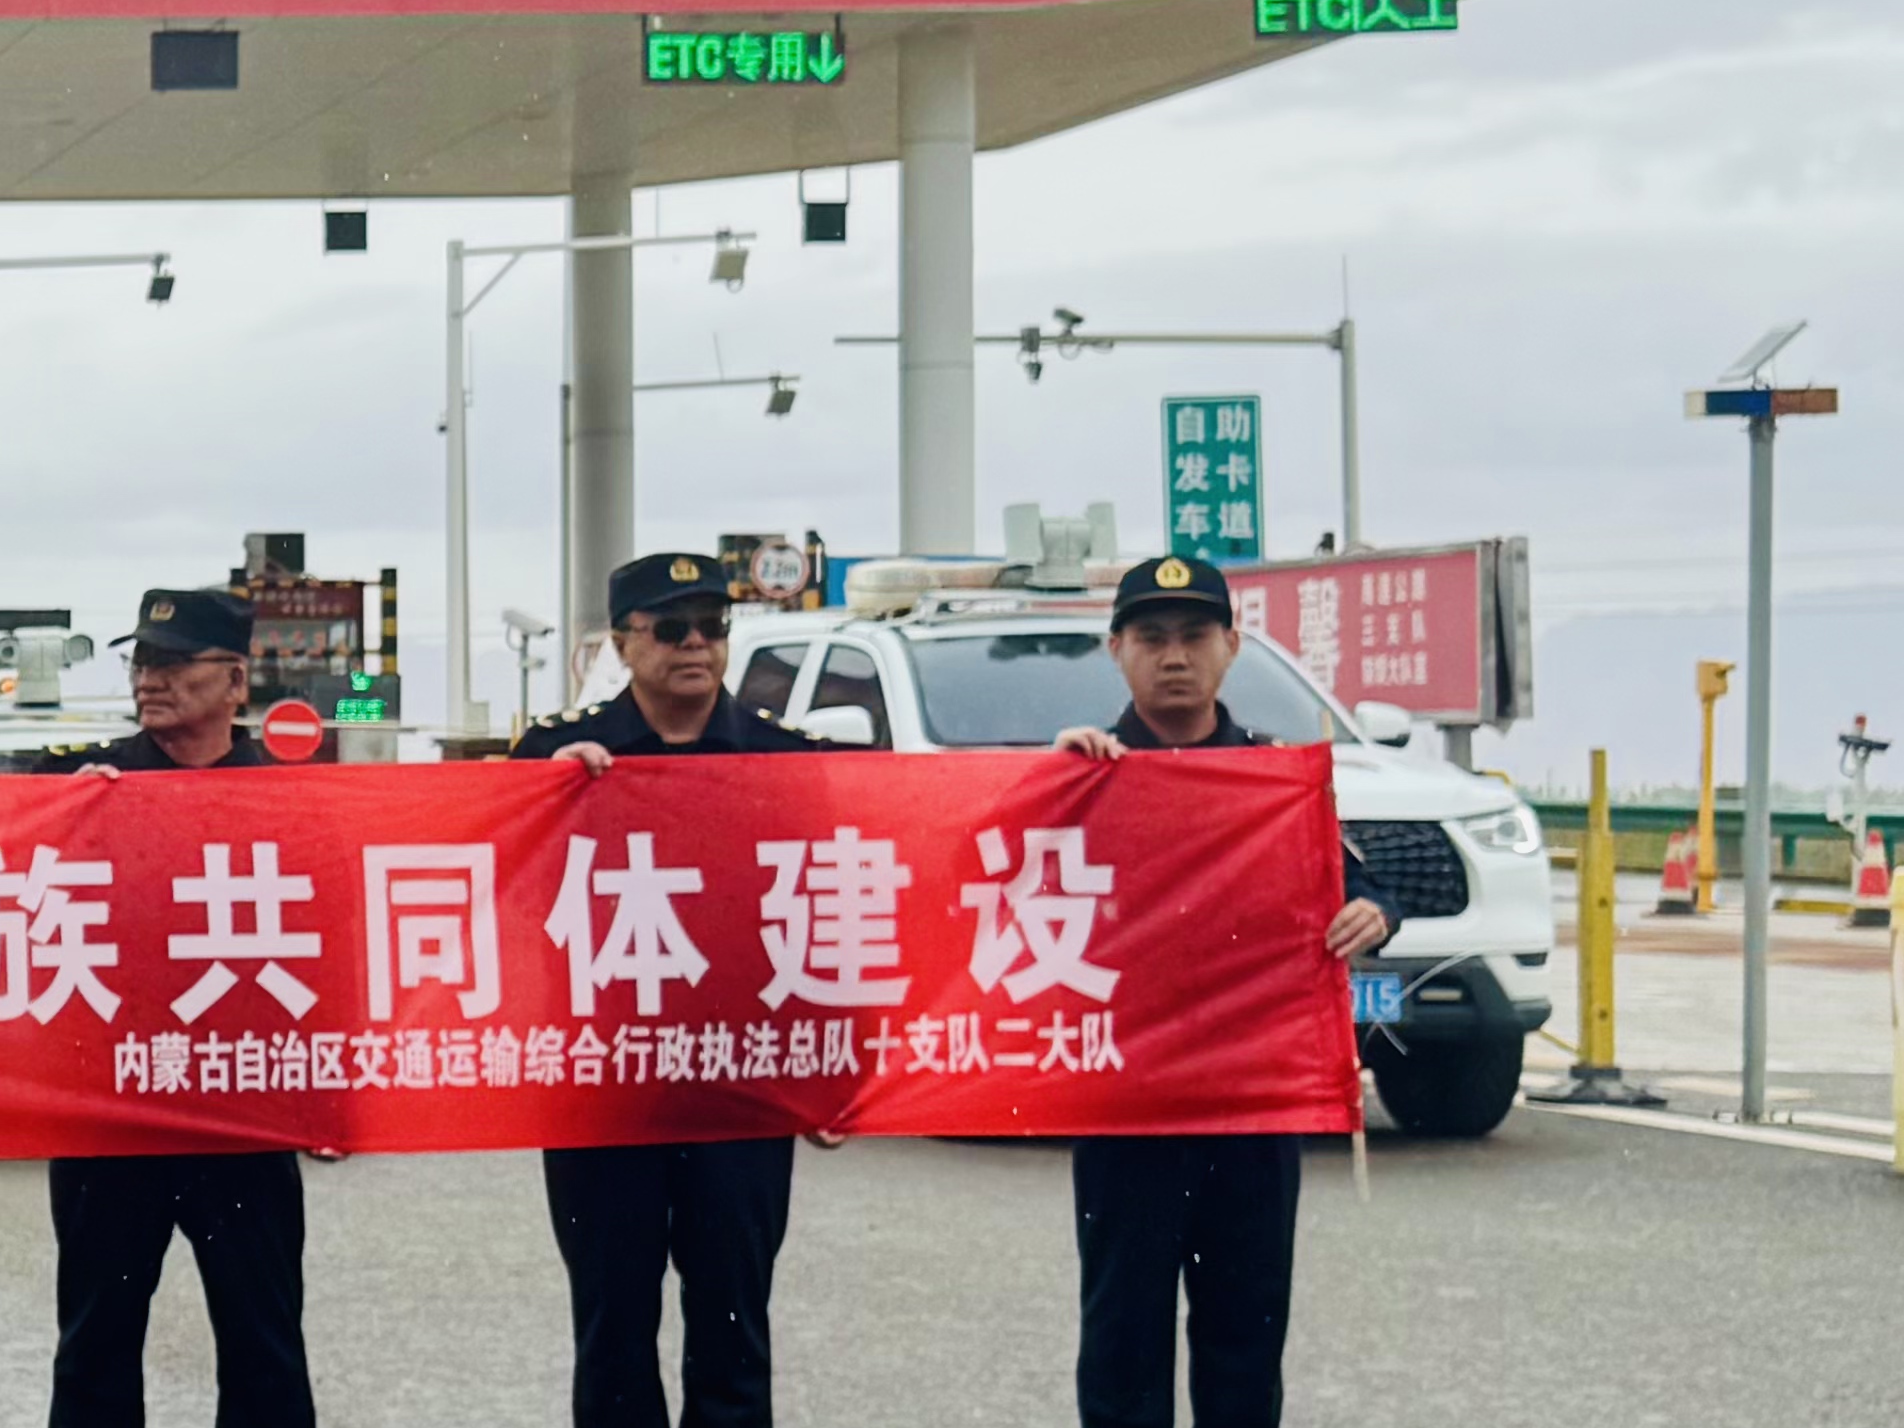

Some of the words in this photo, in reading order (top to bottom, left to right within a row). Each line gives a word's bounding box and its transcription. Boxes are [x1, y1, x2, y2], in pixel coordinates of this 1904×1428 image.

[1176, 405, 1251, 444] 自助
[1175, 452, 1252, 492] 发卡
[1175, 501, 1255, 541] 车道
[113, 1009, 1124, 1095] 内蒙古自治区交通运输综合行政执法总队十支队二大队
